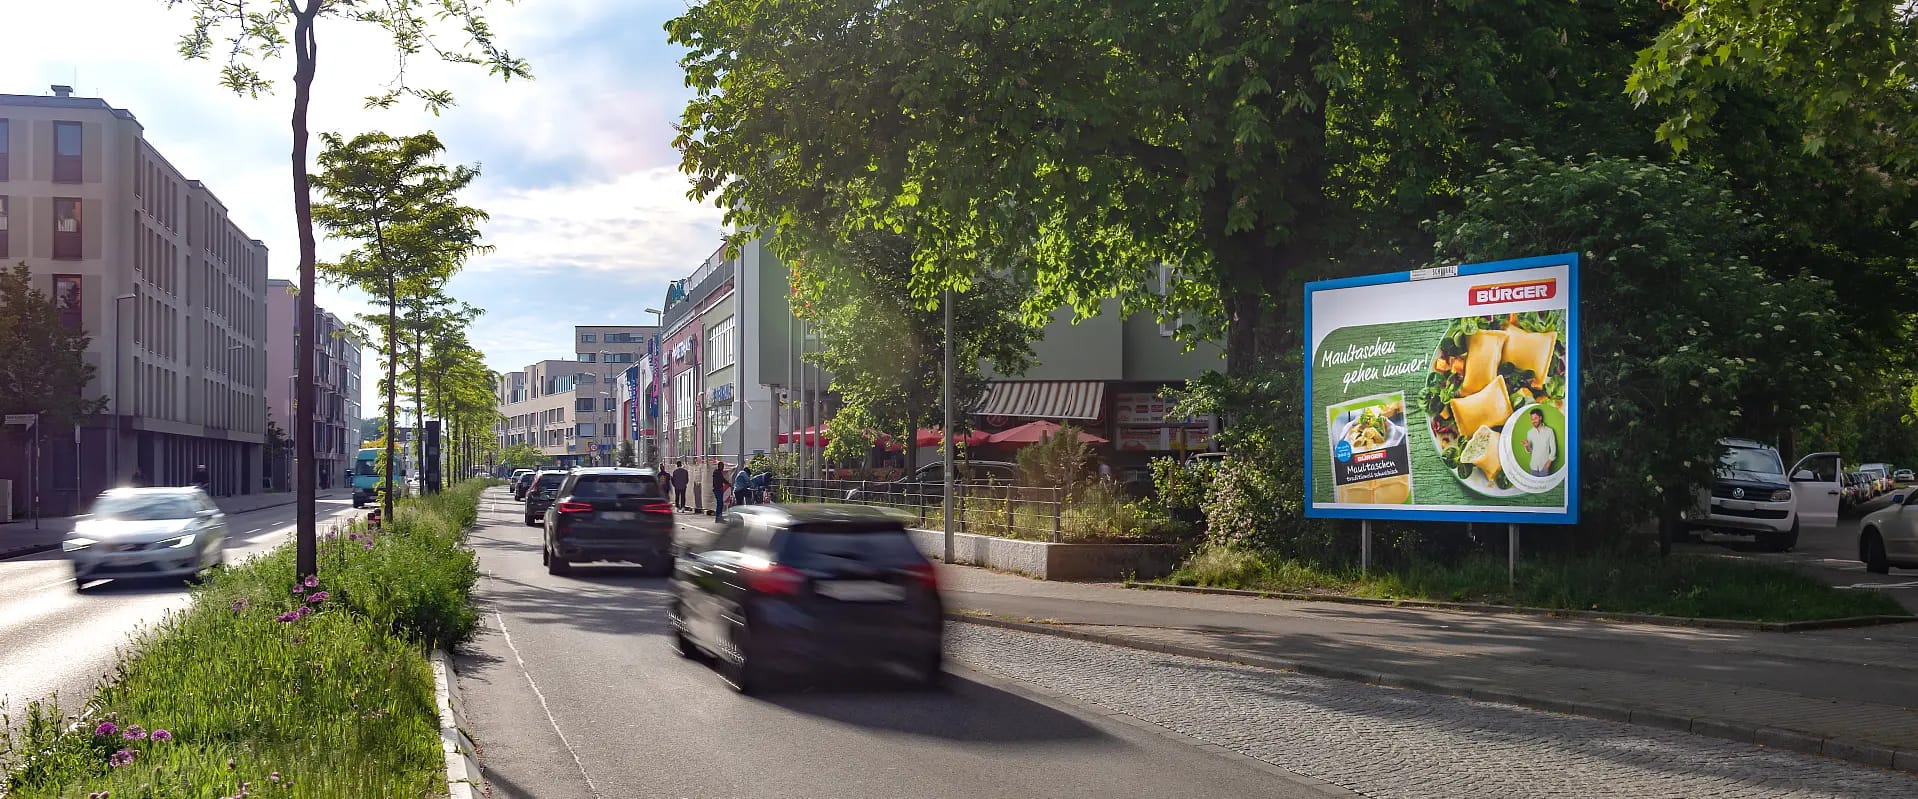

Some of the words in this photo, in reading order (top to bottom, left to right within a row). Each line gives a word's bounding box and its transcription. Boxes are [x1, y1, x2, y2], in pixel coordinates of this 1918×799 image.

[1476, 285, 1548, 303] BÜRGER
[1321, 336, 1396, 368] Maultaschen
[1343, 363, 1379, 394] gehen
[1382, 353, 1428, 377] immer!
[1347, 460, 1396, 475] Maultaschen
